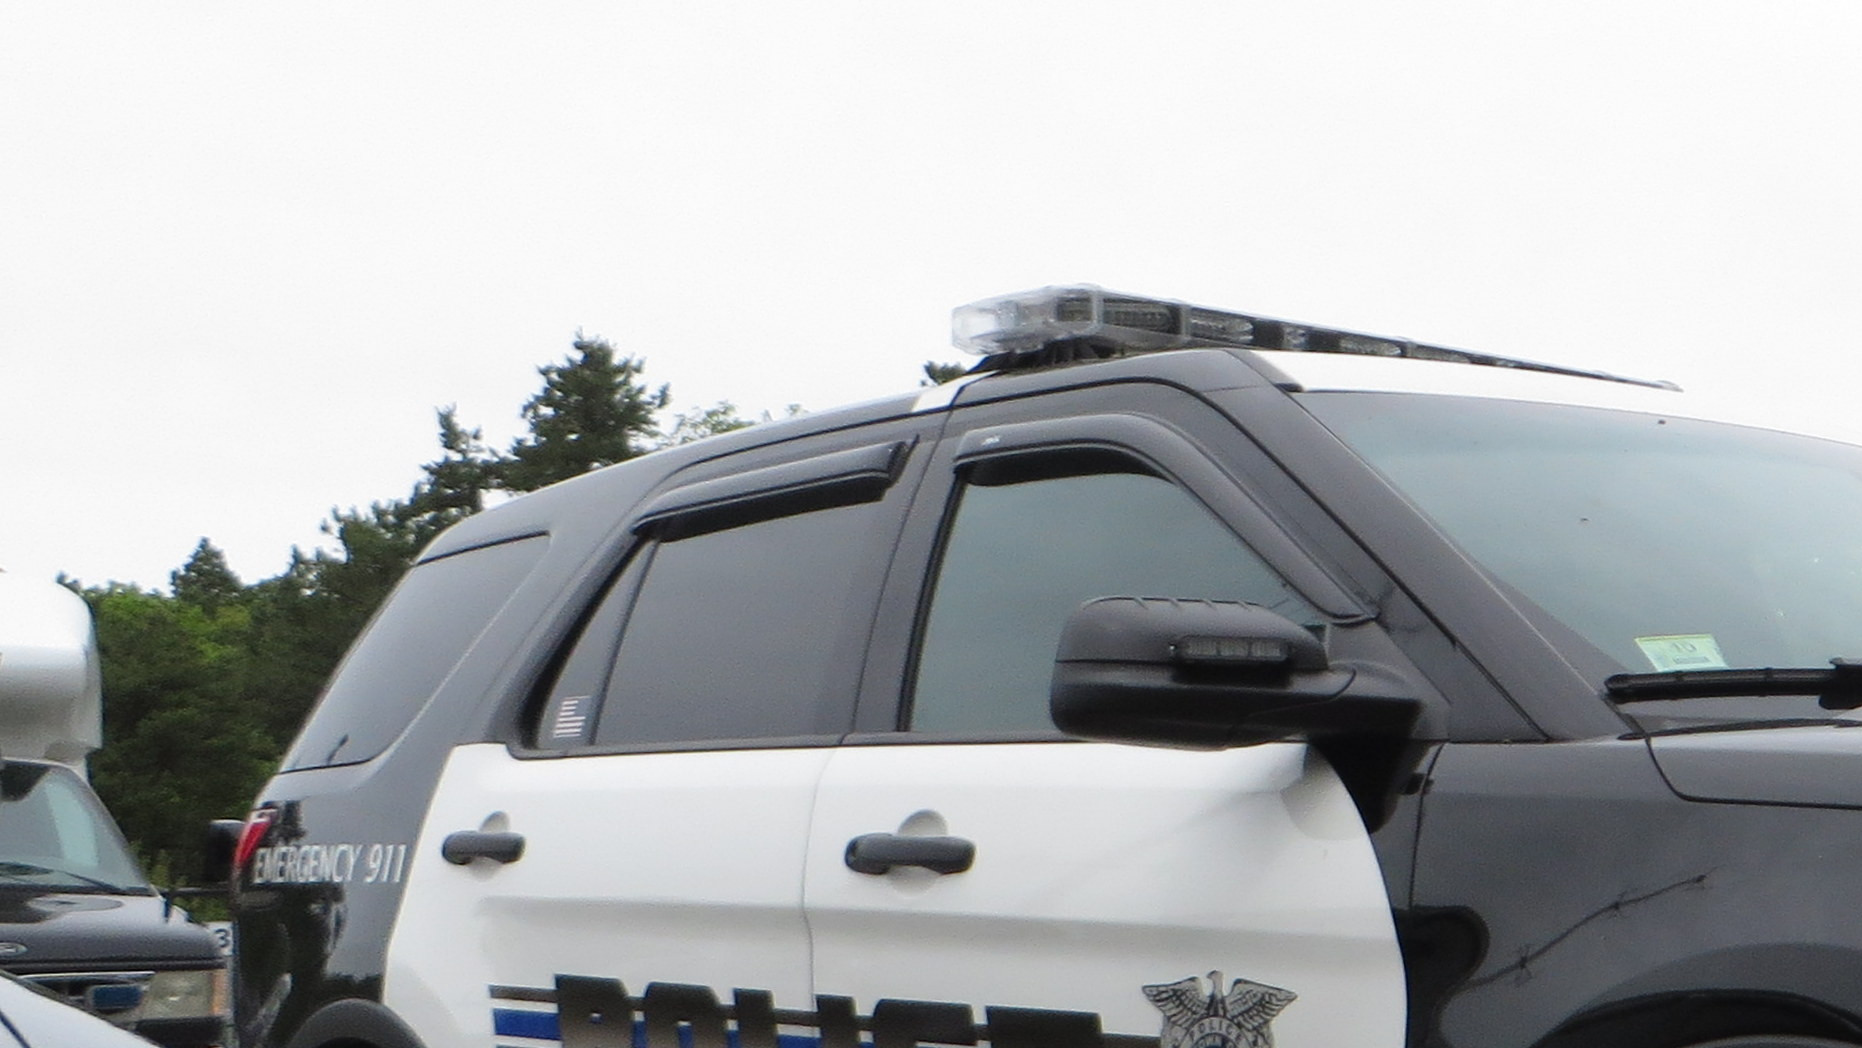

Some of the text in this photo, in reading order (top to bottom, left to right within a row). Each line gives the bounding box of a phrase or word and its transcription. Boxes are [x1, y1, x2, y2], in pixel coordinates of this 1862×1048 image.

[252, 844, 408, 884] EMERGENCY 911
[1188, 1019, 1244, 1044] POLICE
